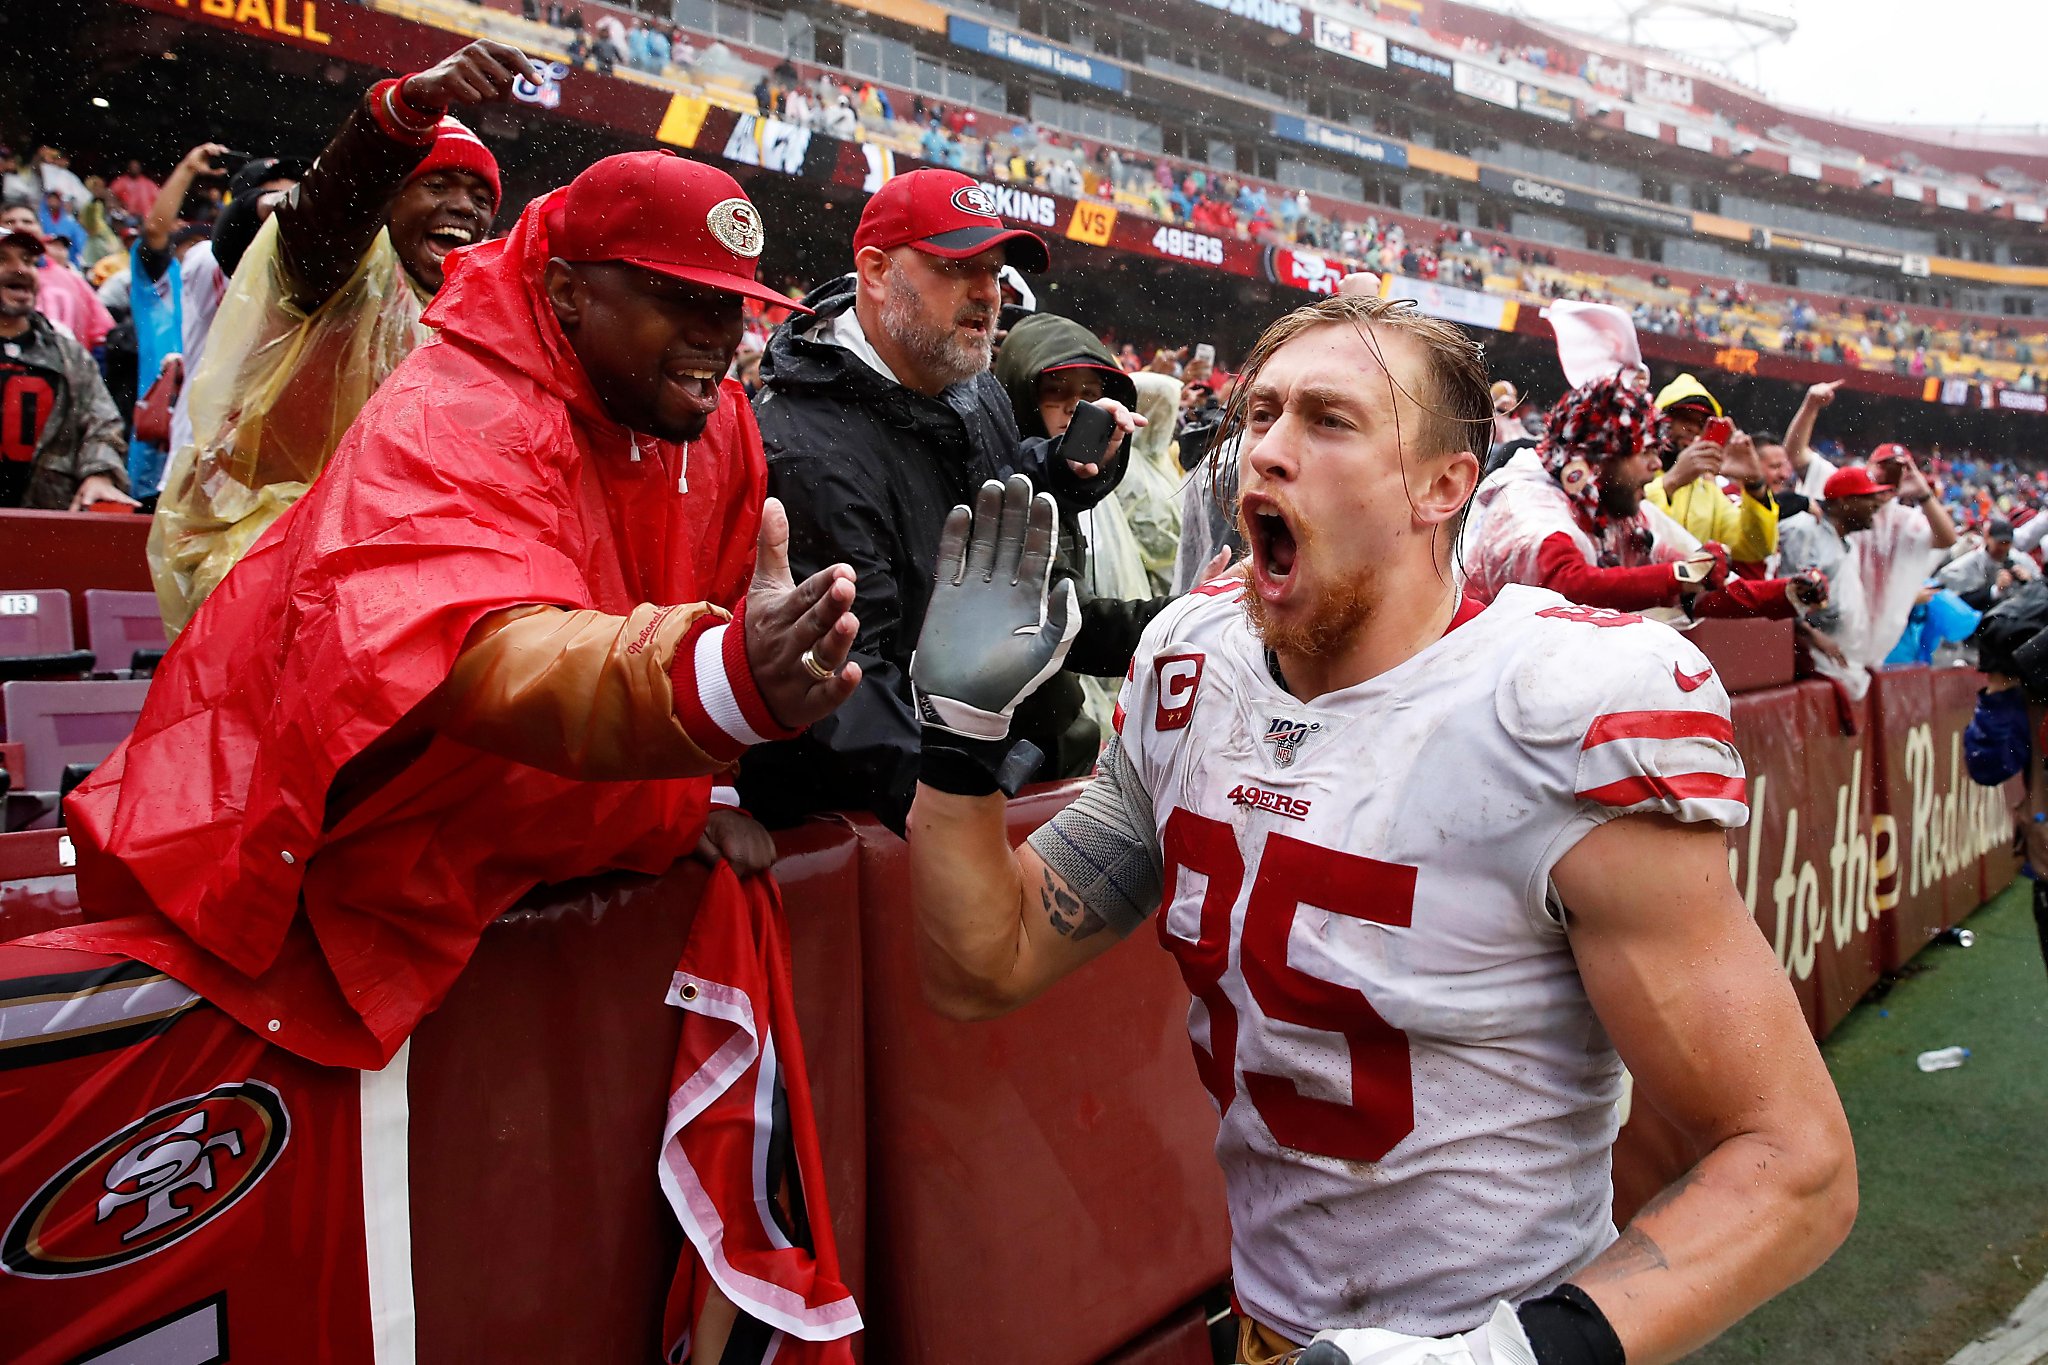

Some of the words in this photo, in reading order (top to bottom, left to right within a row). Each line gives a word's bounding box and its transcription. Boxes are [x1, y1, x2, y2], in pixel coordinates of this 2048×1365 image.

[175, 0, 332, 44] BALL
[1080, 209, 1106, 236] VS
[1152, 226, 1224, 265] 49ERS
[10, 597, 27, 612] 13
[627, 611, 662, 655] National
[1160, 659, 1198, 710] C
[1227, 784, 1311, 816] 49ERS
[1829, 749, 1902, 951] the
[1155, 806, 1419, 1162] 85
